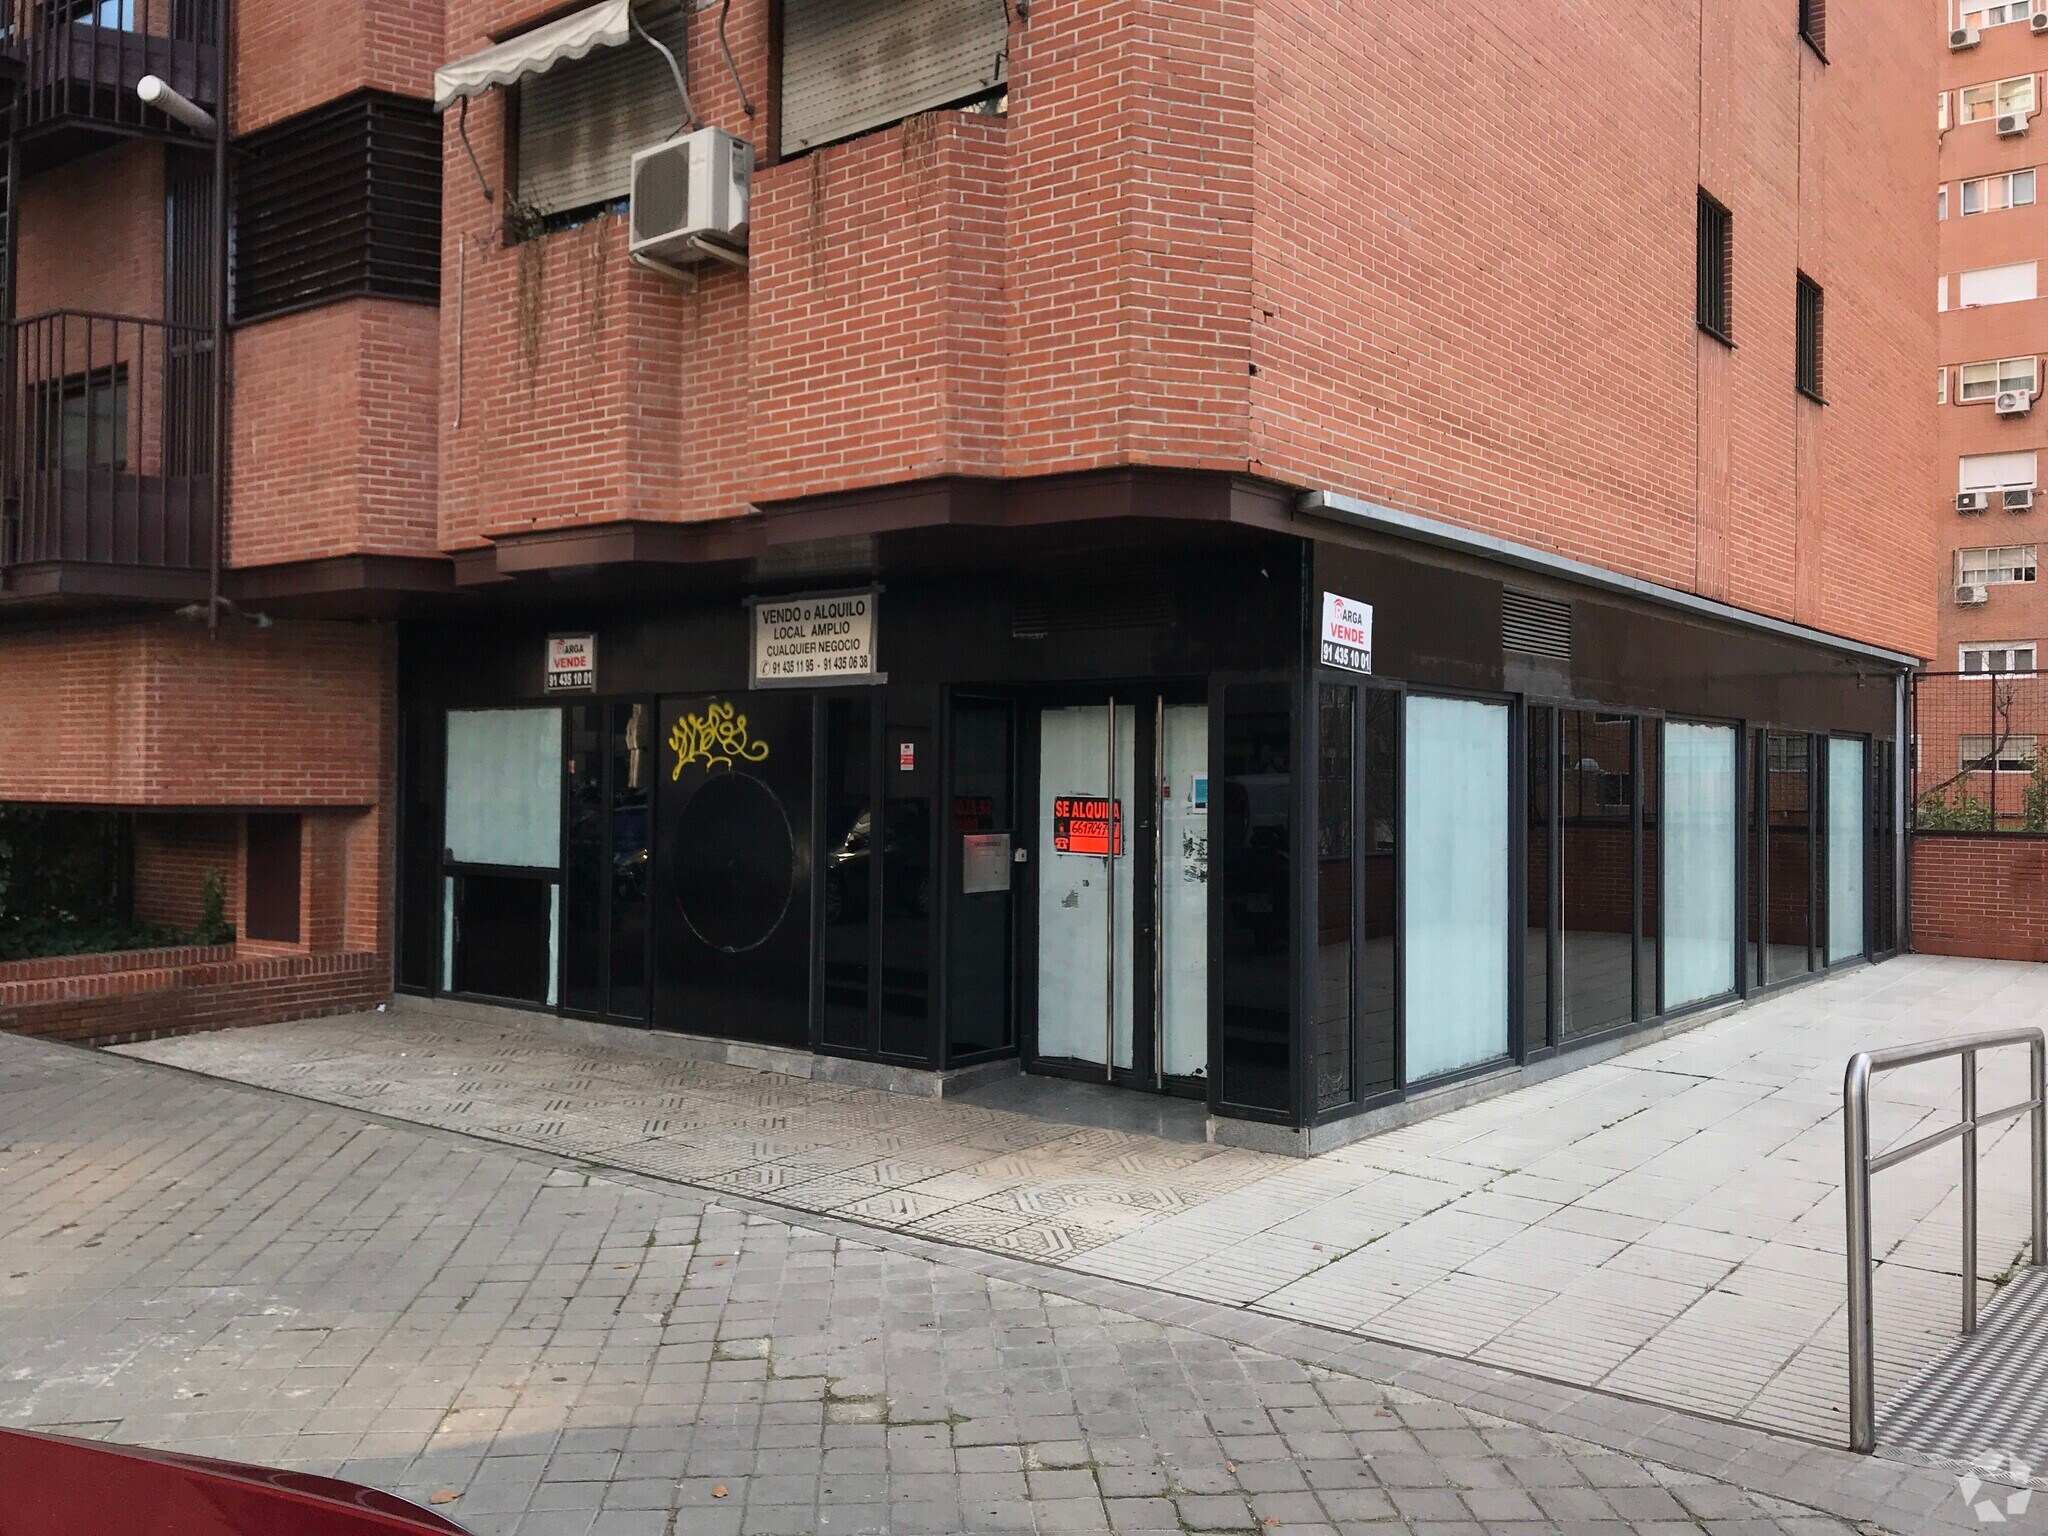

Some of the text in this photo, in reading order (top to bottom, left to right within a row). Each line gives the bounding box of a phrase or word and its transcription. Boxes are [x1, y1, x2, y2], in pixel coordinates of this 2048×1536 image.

[762, 607, 801, 624] VENDO
[813, 600, 865, 620] ALQUILO
[774, 621, 850, 640] LOCAL AMPLIO
[1331, 623, 1364, 645] VENDE
[766, 638, 860, 657] CUALQUIER NEGOCIO
[1323, 643, 1369, 670] 91 435 10 01
[554, 656, 587, 668] VENDE
[772, 662, 781, 674] 91
[782, 661, 795, 674] 435
[797, 660, 804, 673] 11
[806, 659, 814, 672] 95
[824, 658, 832, 671] 91
[834, 657, 847, 670] 435
[849, 656, 858, 669] 06
[860, 655, 868, 669] 38
[549, 672, 592, 687] 91 435 10 01
[1056, 801, 1120, 819] SE ALQUIA
